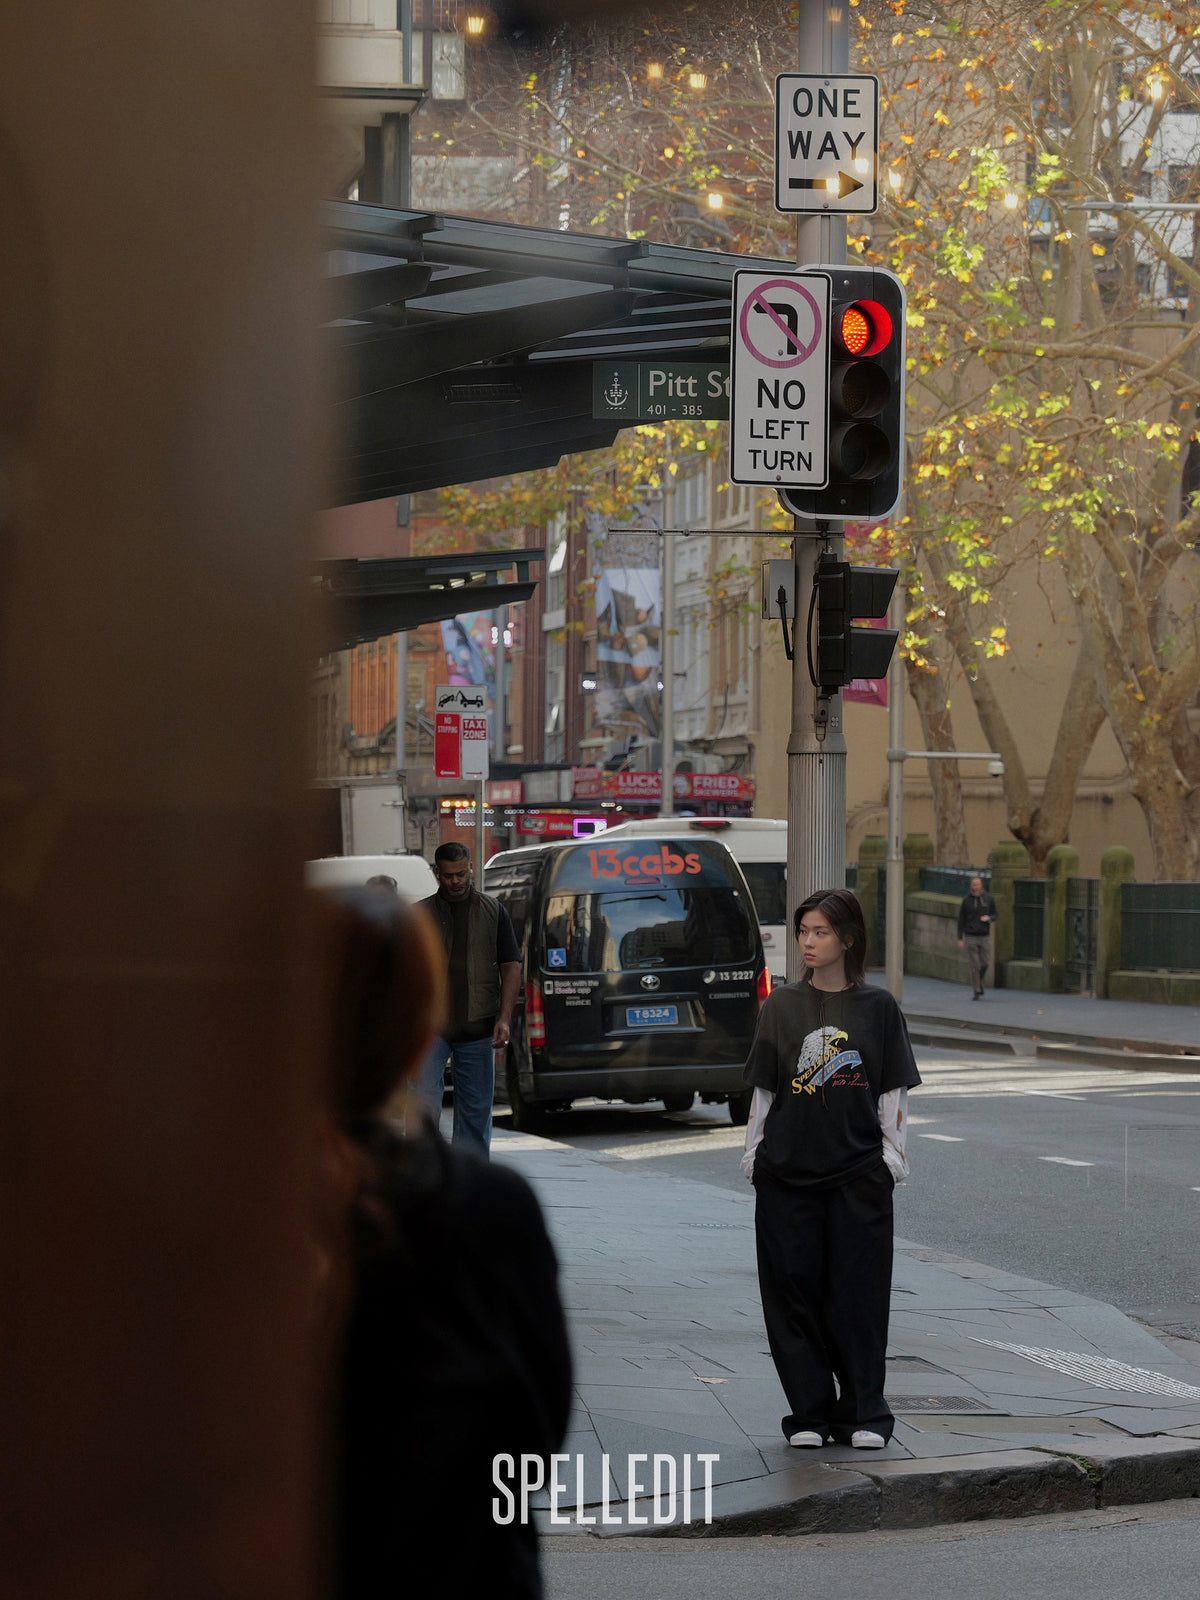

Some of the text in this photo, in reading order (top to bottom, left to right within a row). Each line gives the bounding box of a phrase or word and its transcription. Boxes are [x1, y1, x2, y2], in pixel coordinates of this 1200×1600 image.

[792, 87, 861, 118] ONE
[788, 131, 866, 161] WAY
[649, 370, 698, 398] Pitt
[757, 378, 806, 411] NO
[647, 404, 666, 416] 401
[682, 404, 703, 416] 385
[749, 418, 810, 441] LEFT
[748, 449, 812, 472] TURN
[443, 716, 452, 724] NO
[463, 719, 486, 729] TAXI
[437, 725, 458, 734] STOPPING
[463, 730, 486, 739] ZONE
[693, 775, 740, 789] FRIED
[693, 788, 738, 797] SKEWERS
[587, 846, 702, 878] 13cabs
[719, 970, 754, 981] 13 2227
[708, 991, 750, 1000] COMMUTER
